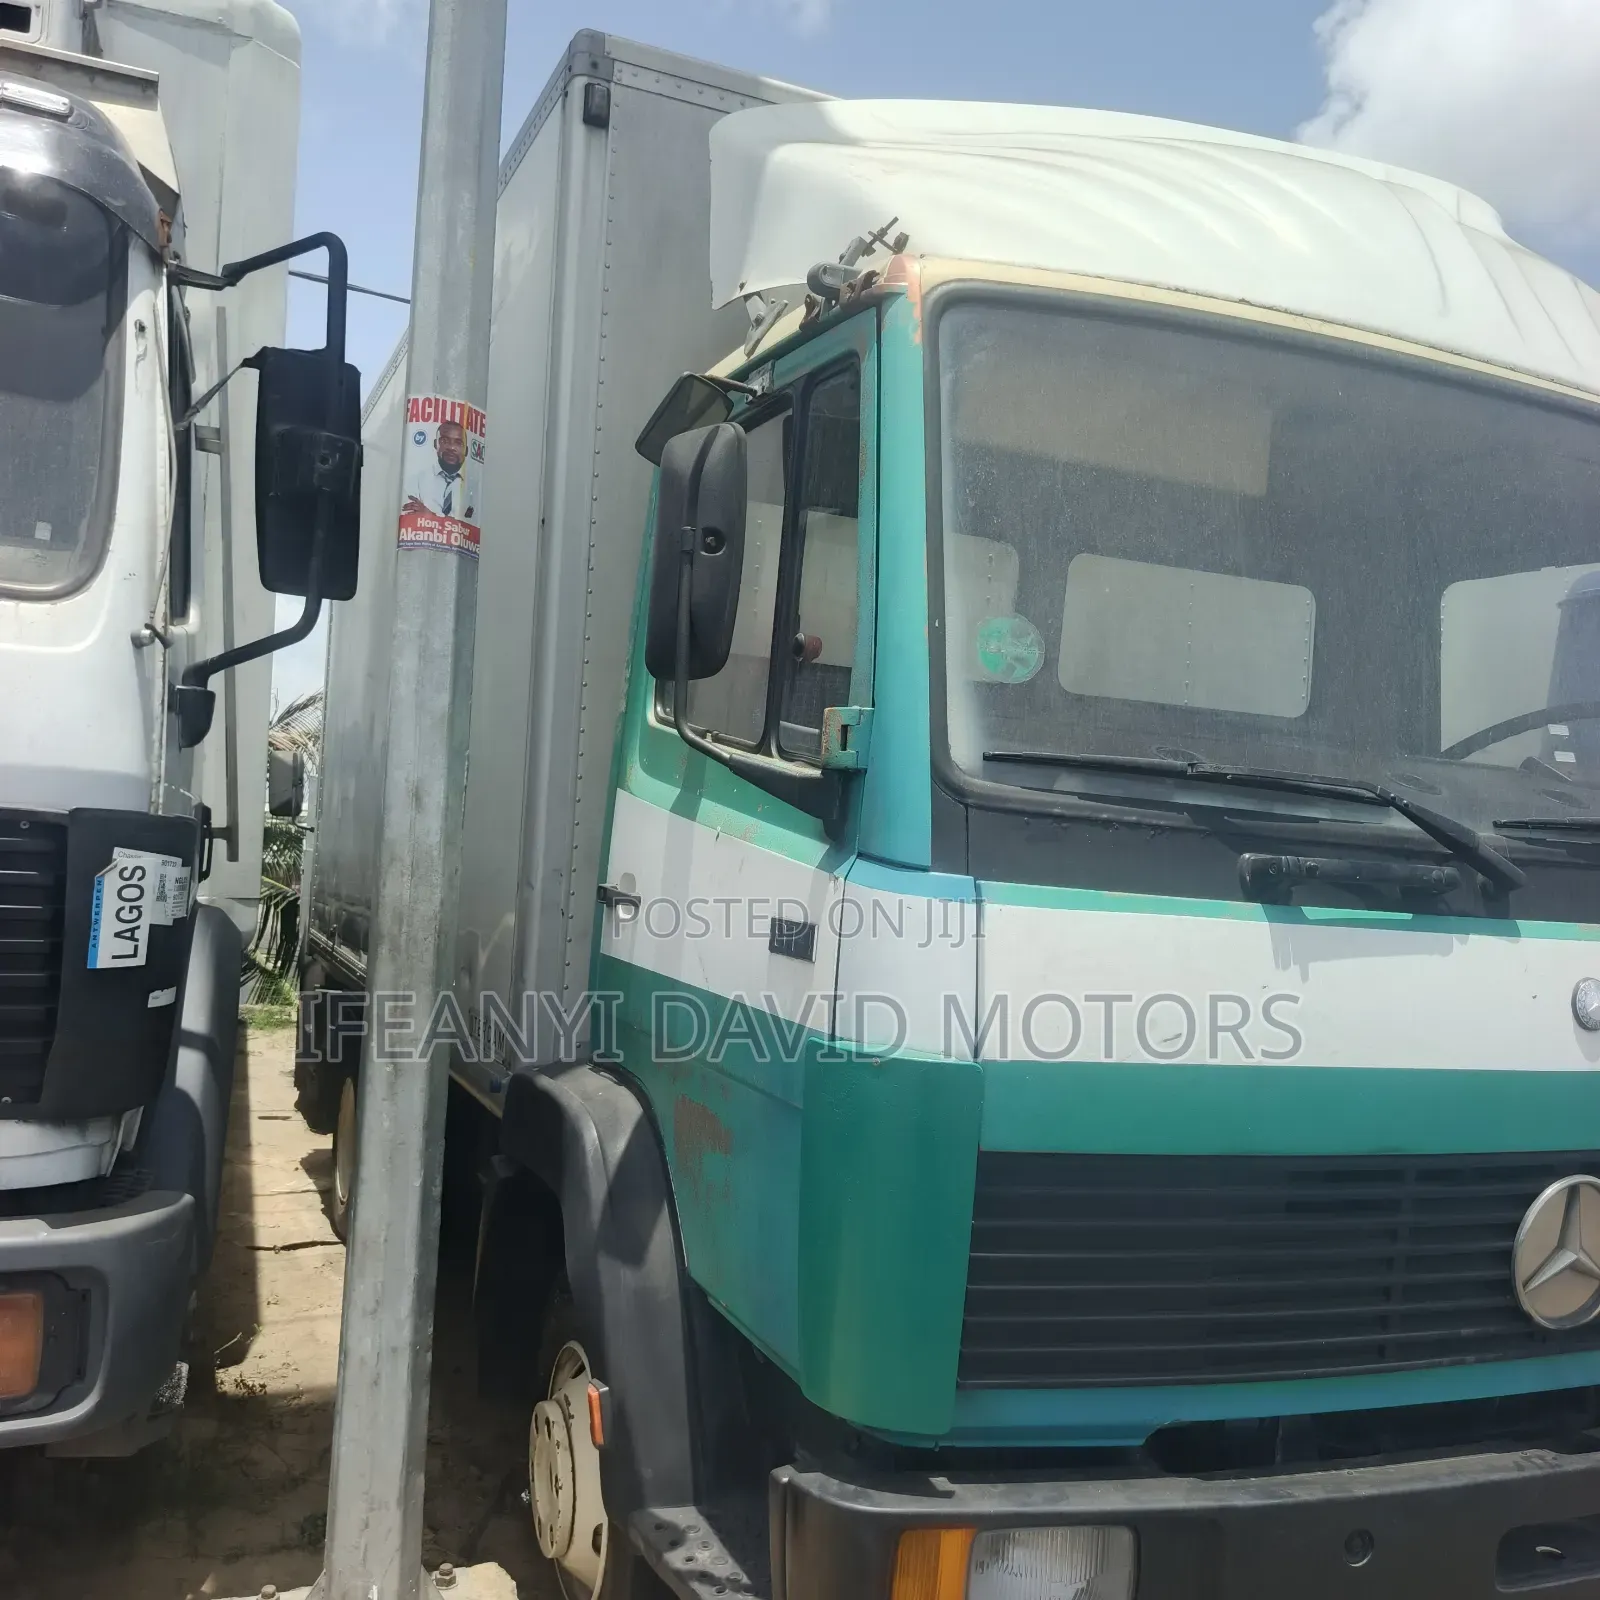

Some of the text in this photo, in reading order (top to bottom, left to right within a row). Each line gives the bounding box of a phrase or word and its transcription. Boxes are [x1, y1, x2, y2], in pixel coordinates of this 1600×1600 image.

[415, 434, 425, 443] by
[399, 527, 448, 544] Akanbi
[417, 517, 471, 536] Hon. Sabur
[91, 879, 103, 949] ANTWERPEN
[111, 865, 147, 960] LAGOS
